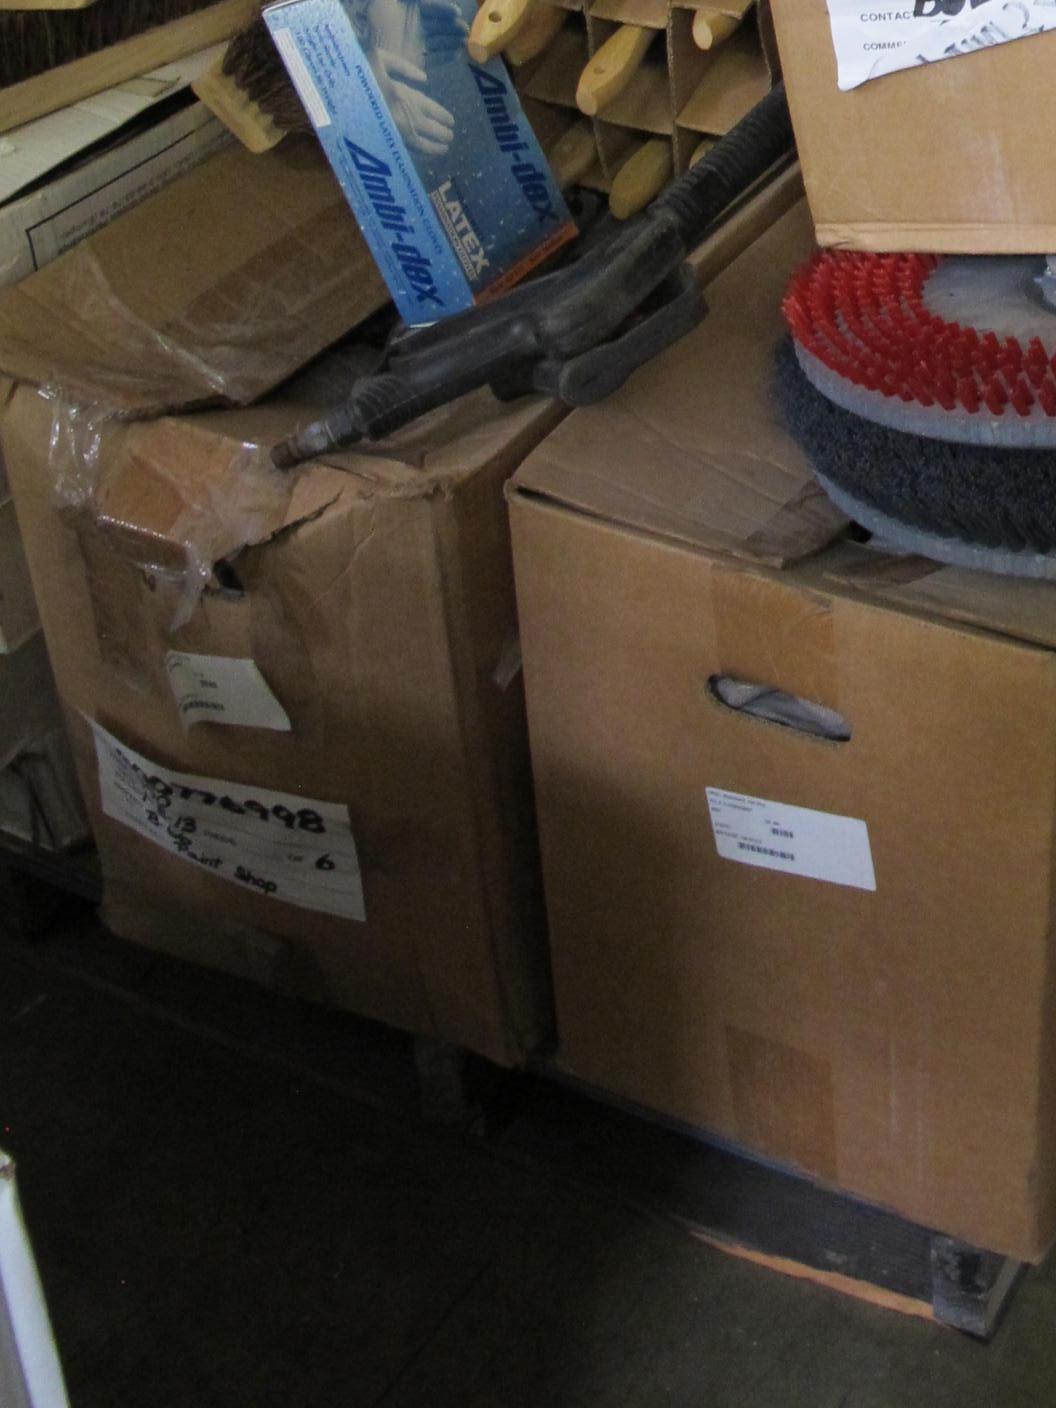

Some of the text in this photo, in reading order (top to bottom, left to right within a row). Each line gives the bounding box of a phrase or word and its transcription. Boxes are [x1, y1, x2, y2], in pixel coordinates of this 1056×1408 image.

[860, 10, 914, 22] CONTAC
[355, 64, 383, 120] POWDERED
[379, 120, 395, 149] LATEX
[469, 63, 559, 223] Ambi-dex
[343, 136, 445, 308] Ambi-dex
[439, 179, 490, 274] LATEX
[234, 864, 278, 895] Shop
[315, 852, 336, 871] 6
